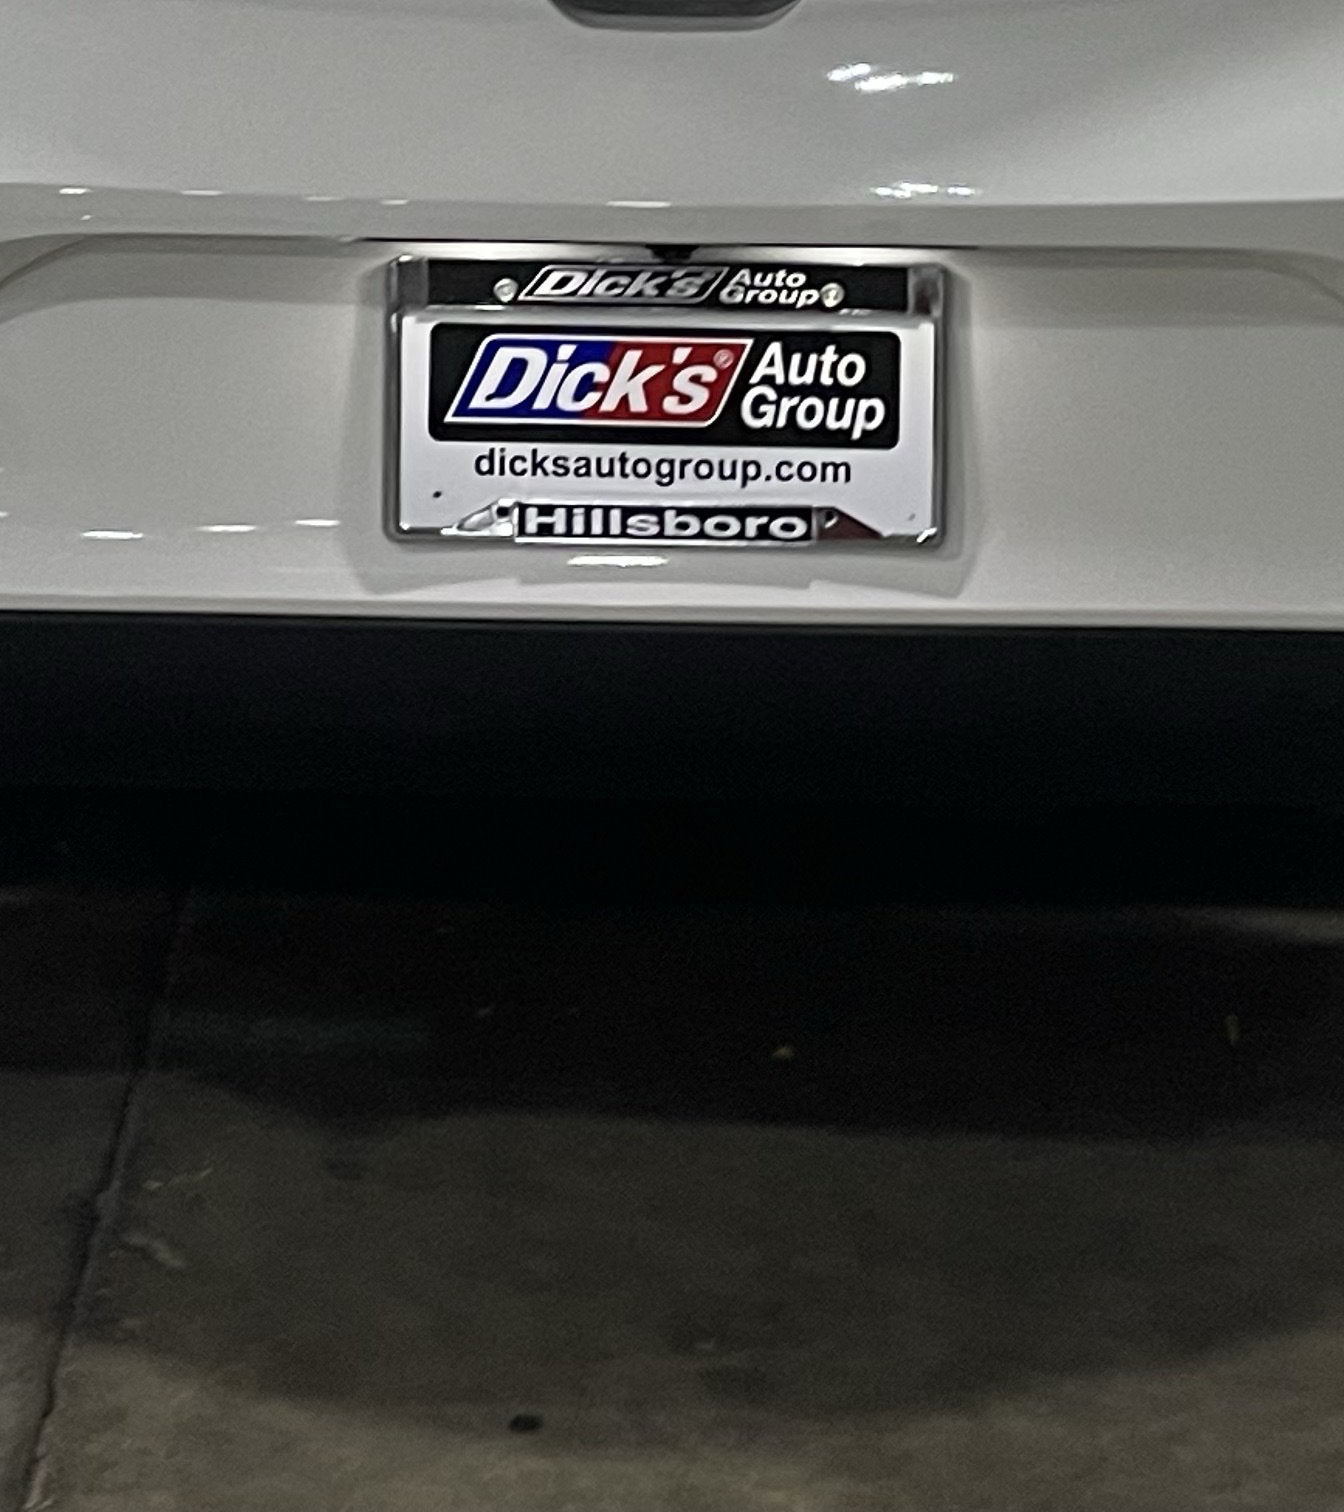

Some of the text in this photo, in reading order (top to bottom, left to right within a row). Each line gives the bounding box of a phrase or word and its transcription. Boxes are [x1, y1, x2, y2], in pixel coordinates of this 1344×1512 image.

[532, 268, 716, 298] Dick's
[718, 284, 821, 309] Group
[733, 268, 807, 289] Auto
[467, 344, 716, 414] Dick's
[749, 342, 866, 387] Auto
[740, 386, 886, 440] Group
[474, 449, 852, 488] dicksautogroup.com
[522, 506, 808, 542] Hillsboro
